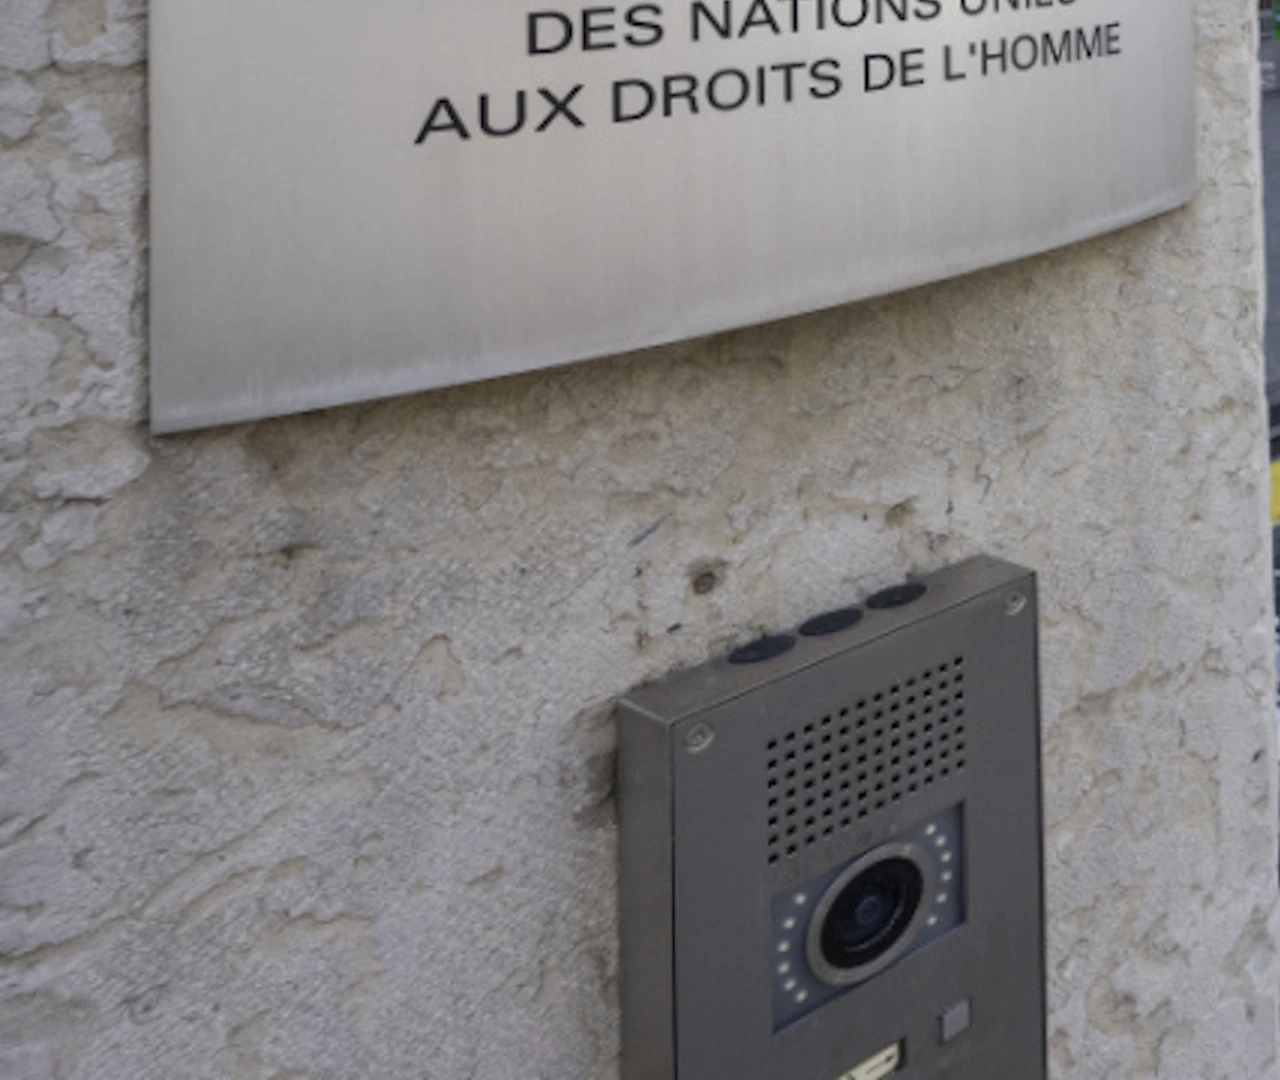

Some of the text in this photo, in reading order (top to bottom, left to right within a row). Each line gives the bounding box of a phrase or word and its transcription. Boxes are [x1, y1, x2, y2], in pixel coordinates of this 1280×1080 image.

[527, 3, 664, 56] DES
[414, 22, 1121, 145] AUX DROITS DE L'HOMME
